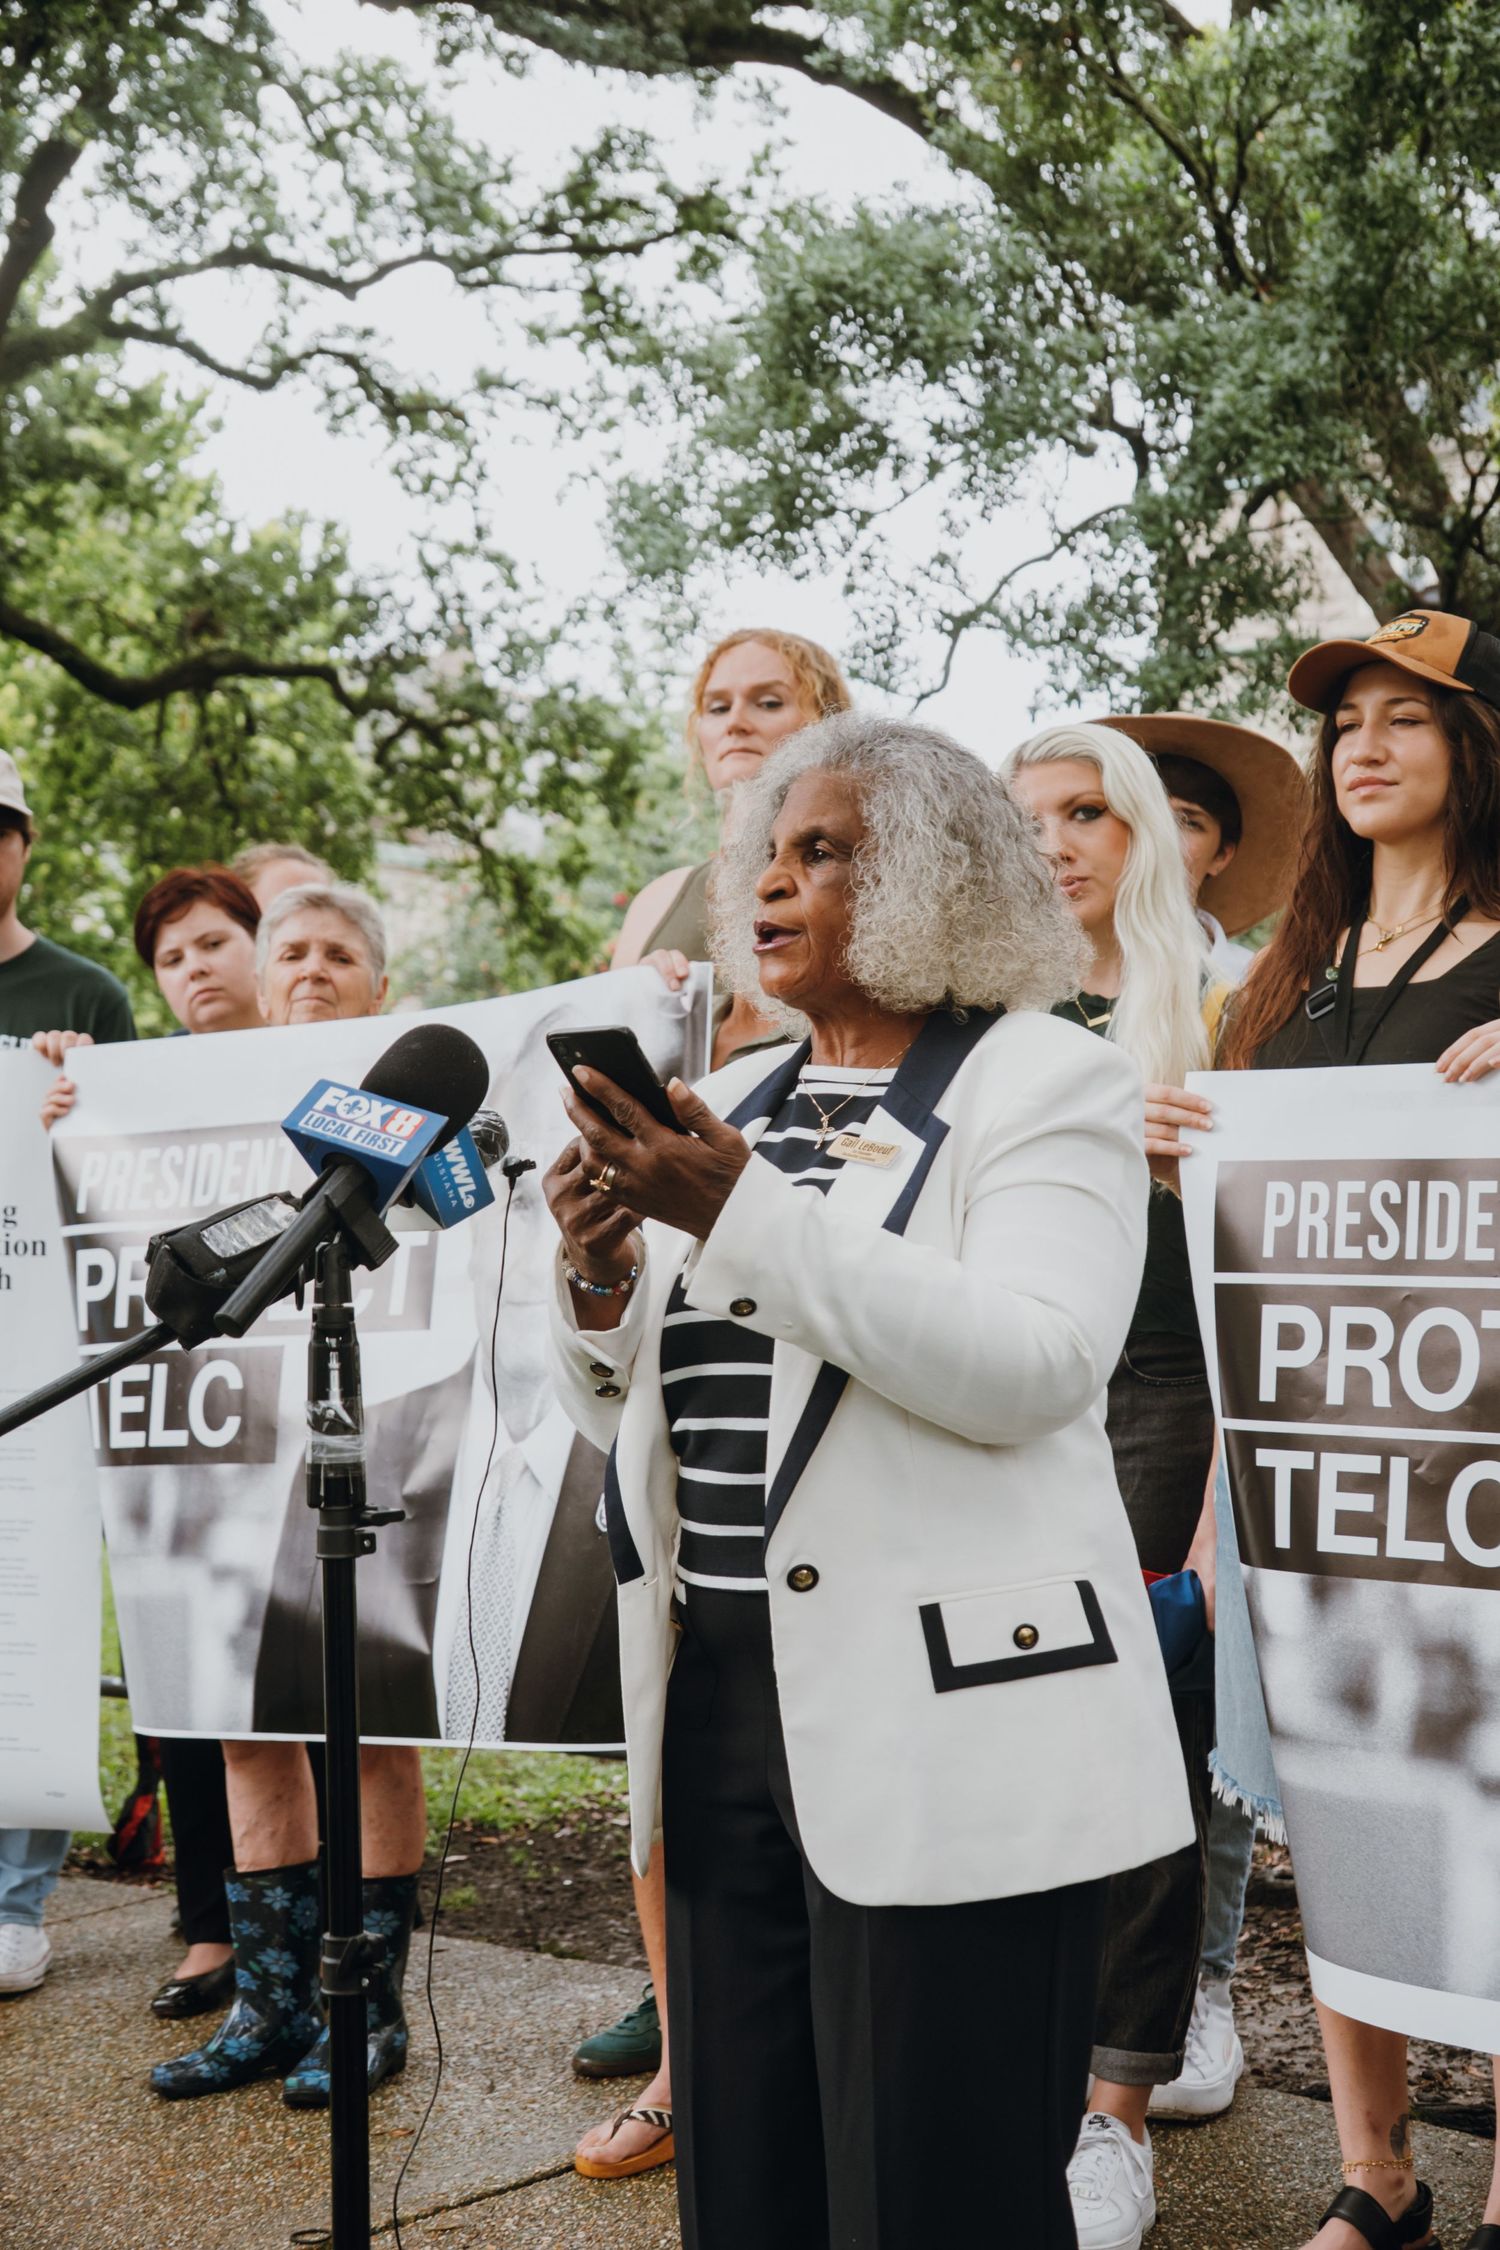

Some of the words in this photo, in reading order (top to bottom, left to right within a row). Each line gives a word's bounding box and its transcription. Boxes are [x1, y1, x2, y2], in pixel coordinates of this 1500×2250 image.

[303, 1112, 351, 1139] LOCAL
[352, 1126, 402, 1154] FIRST
[312, 1086, 396, 1130] FOX
[385, 1109, 424, 1138] 8
[1262, 1179, 1499, 1262] PRESIDE
[0, 1233, 47, 1256] ion
